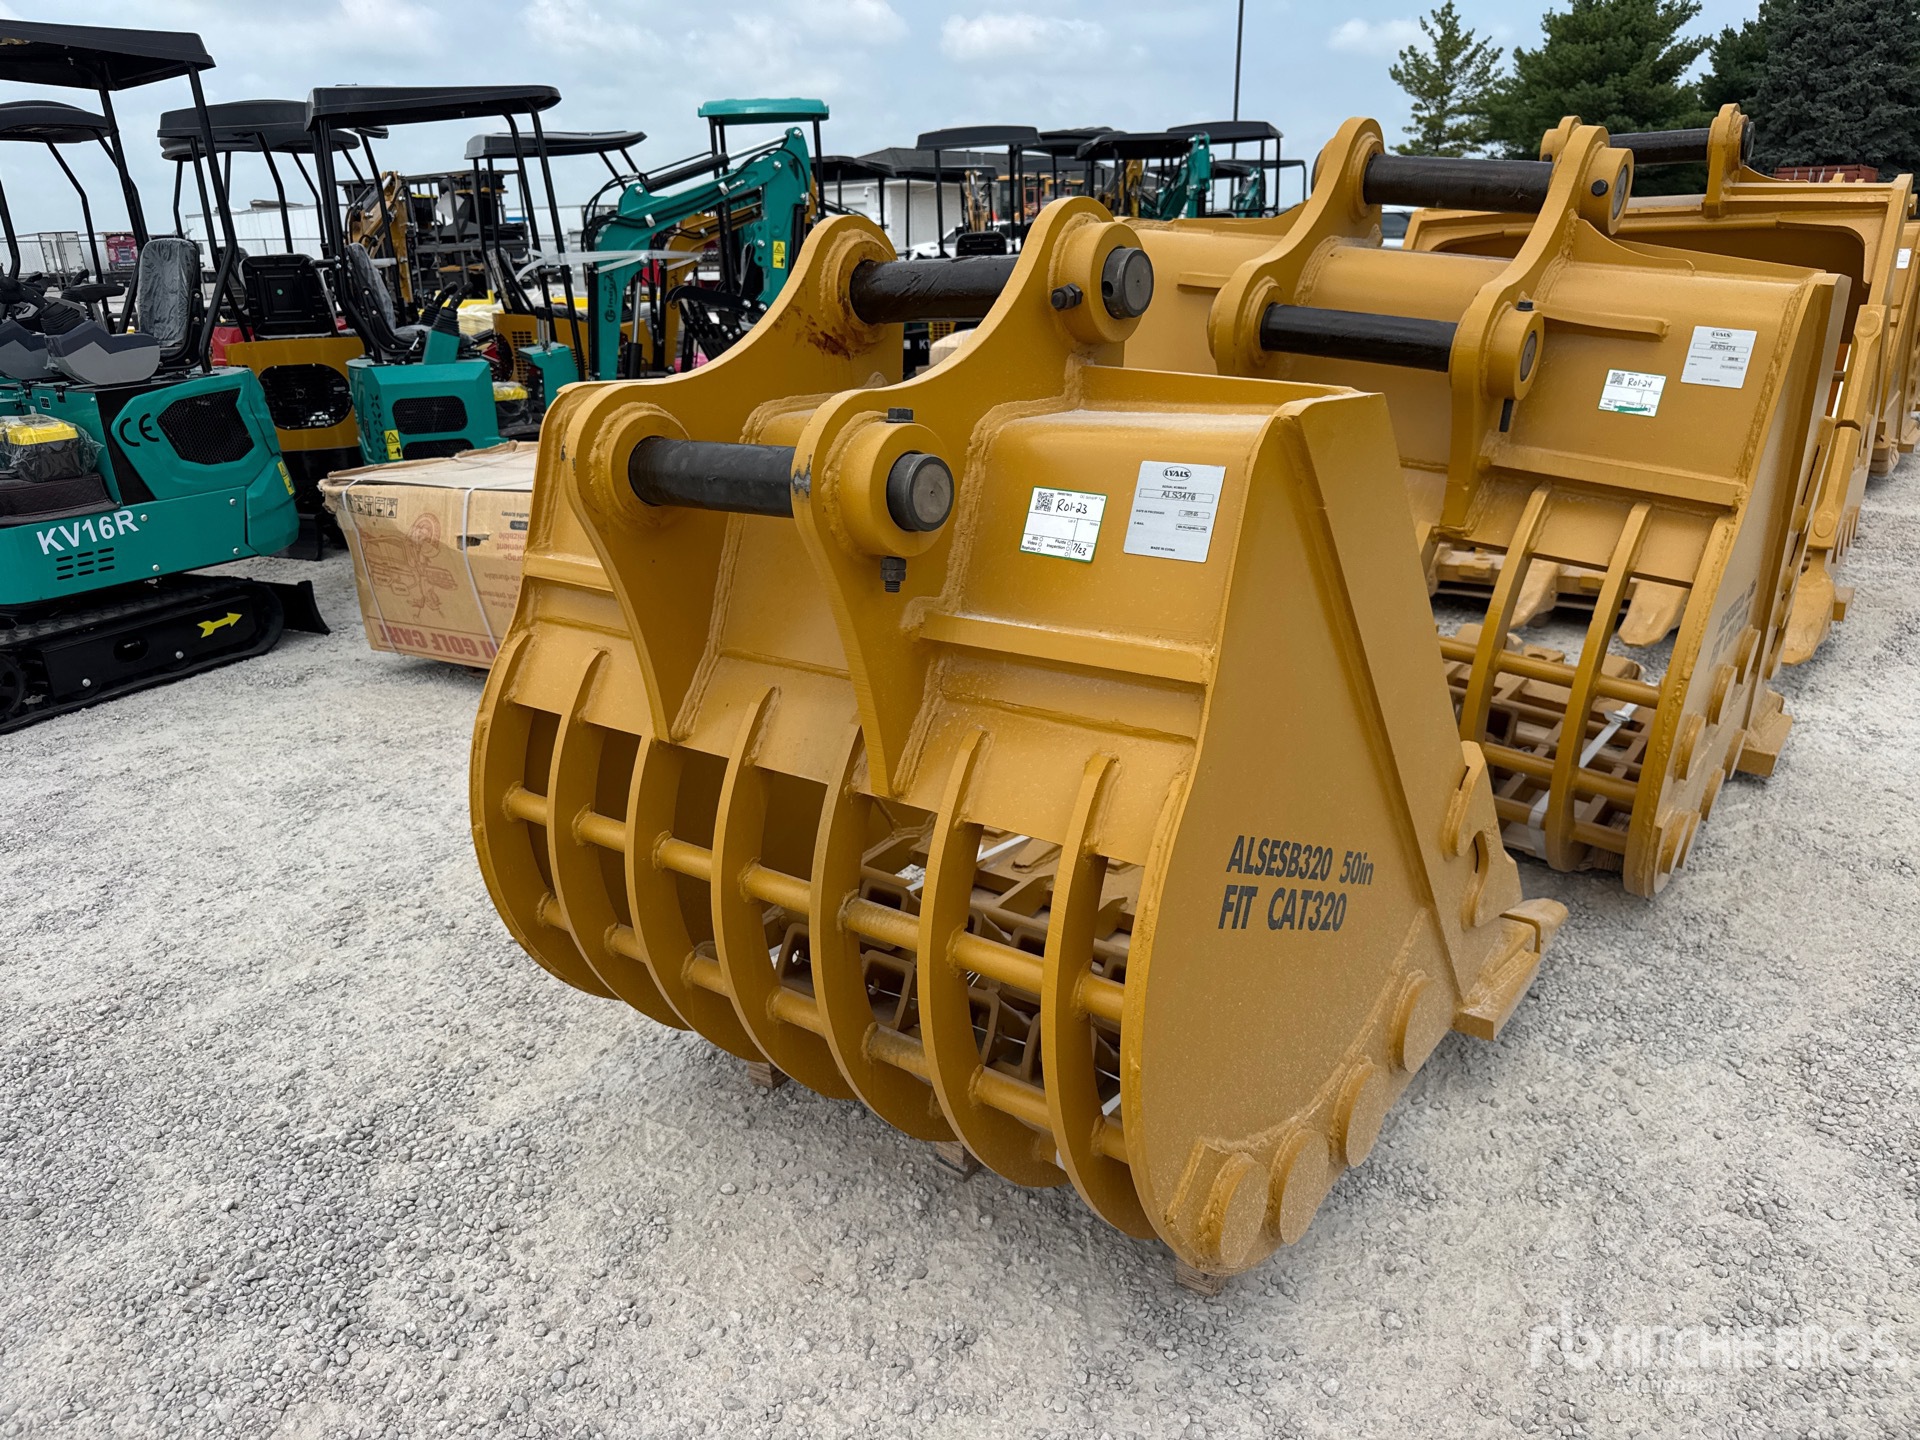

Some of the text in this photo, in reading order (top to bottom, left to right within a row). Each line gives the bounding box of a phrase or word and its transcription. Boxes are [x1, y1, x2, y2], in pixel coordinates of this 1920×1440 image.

[1164, 470, 1190, 478] LYALS
[1161, 490, 1197, 501] ALS3476
[36, 509, 139, 555] KV16R
[379, 624, 428, 649] CART
[430, 632, 480, 657] GOLF
[1226, 835, 1374, 885] ALSESB320 50in
[1218, 885, 1347, 931] FIT CAT320
